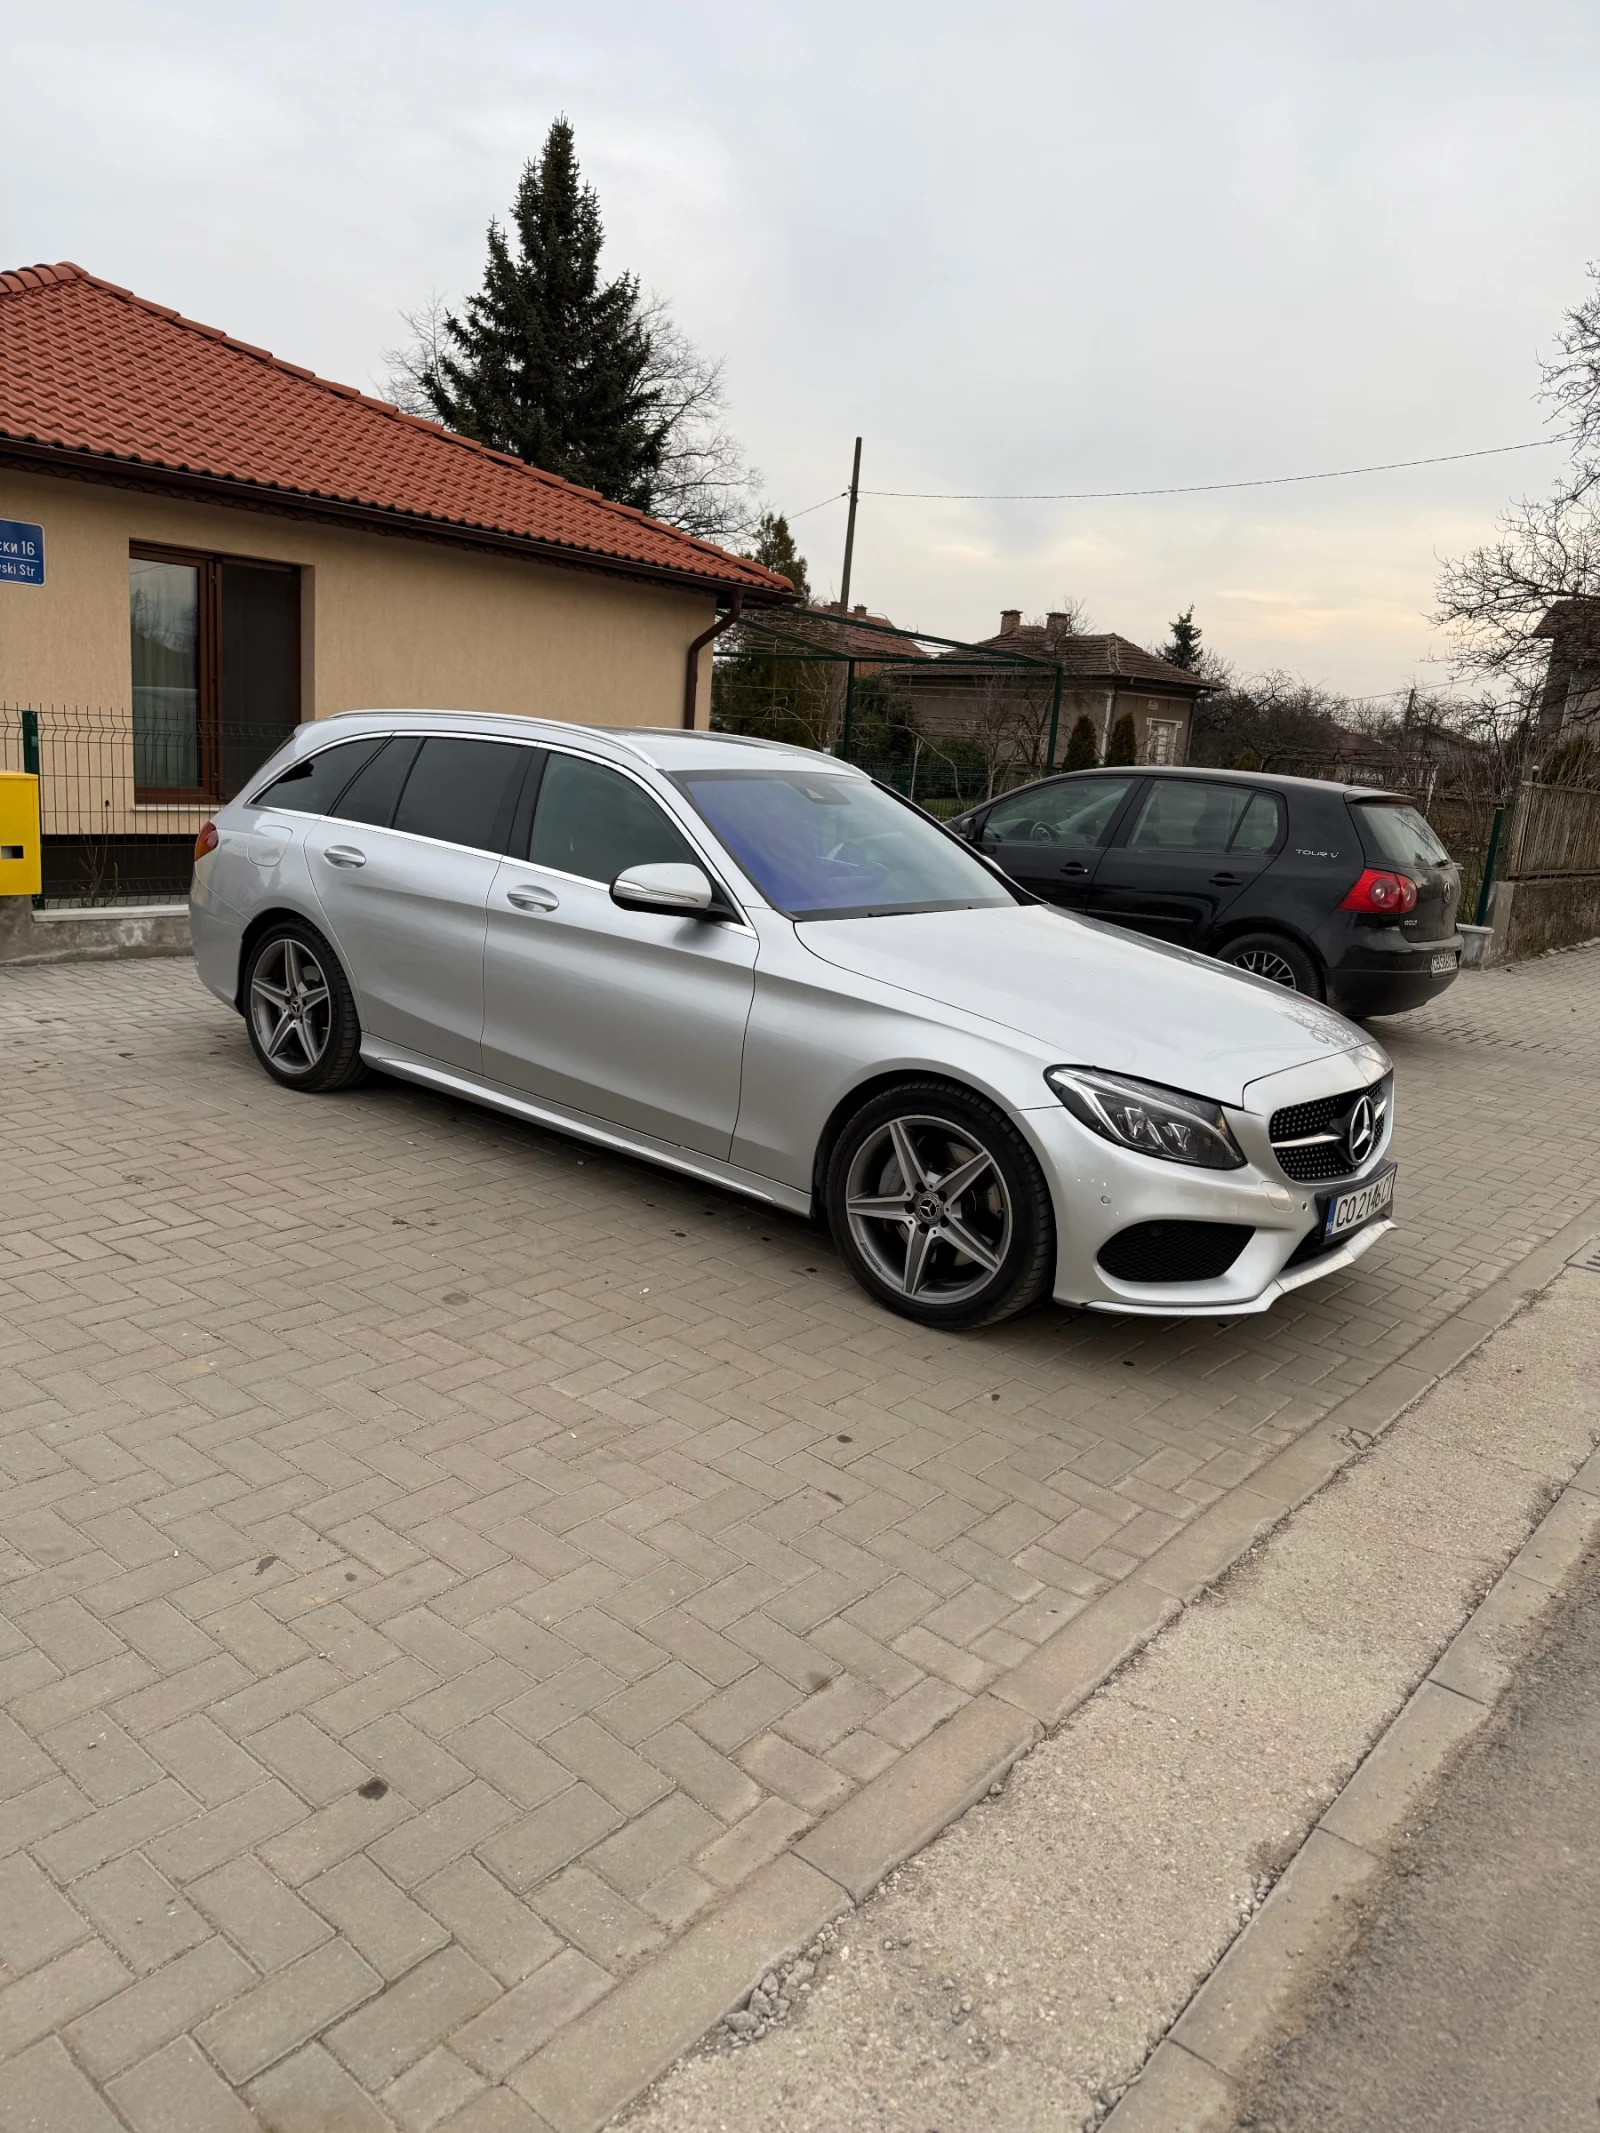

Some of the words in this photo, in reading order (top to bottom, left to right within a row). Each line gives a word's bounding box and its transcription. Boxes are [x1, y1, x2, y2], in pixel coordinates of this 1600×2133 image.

[21, 540, 35, 556] 16
[0, 562, 17, 575] ski
[19, 564, 35, 577] Str
[1295, 849, 1328, 858] TOUR
[1336, 1195, 1357, 1228] CO
